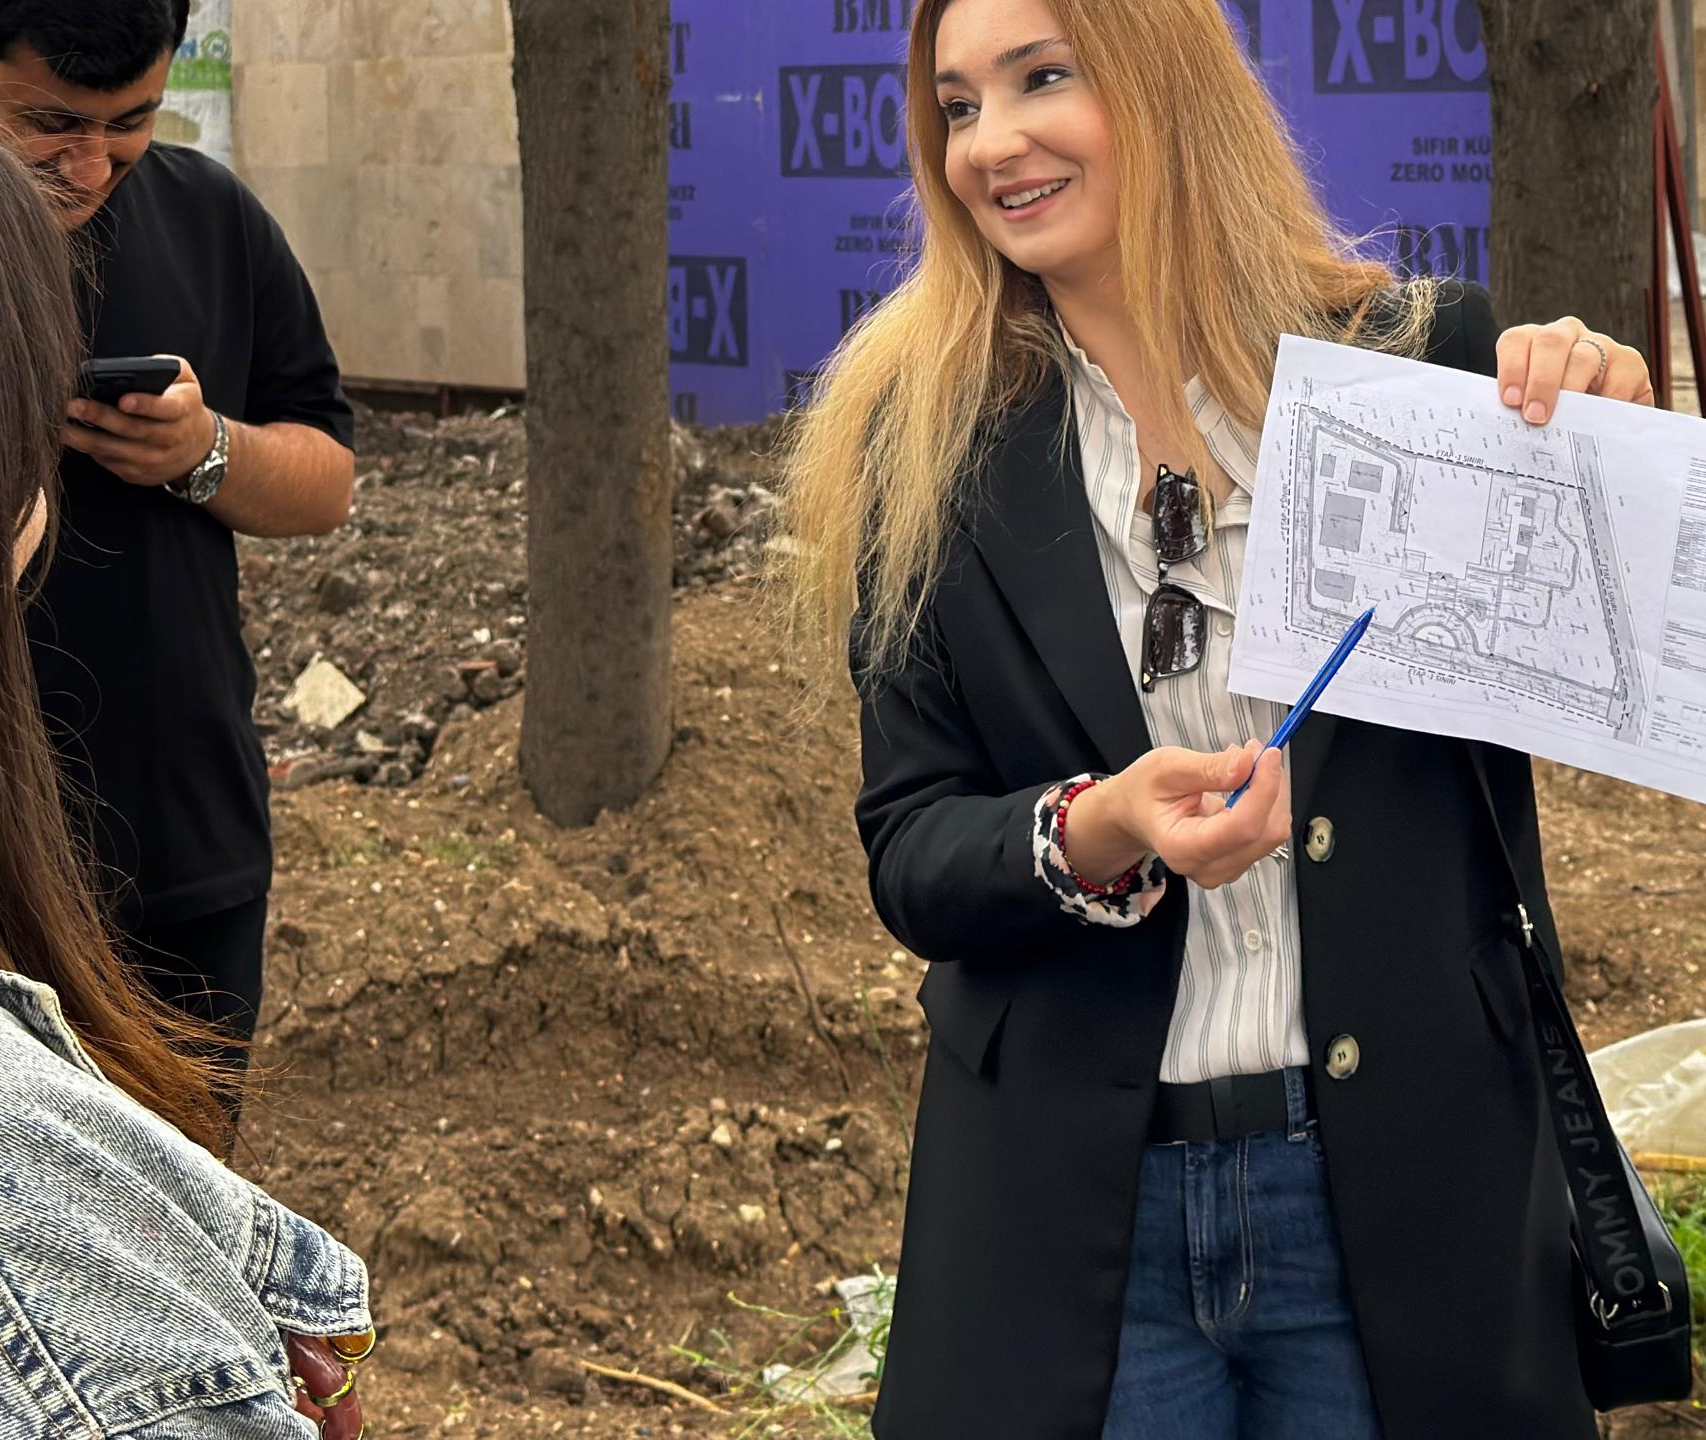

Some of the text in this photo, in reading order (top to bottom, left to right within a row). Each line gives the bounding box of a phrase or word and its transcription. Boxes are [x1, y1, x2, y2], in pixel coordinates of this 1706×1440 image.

[789, 73, 907, 171] X-BO
[1412, 133, 1493, 157] SIFIR KÜ
[1390, 163, 1445, 183] ZERO
[1399, 224, 1492, 278] BM
[1435, 448, 1454, 459] ETAP
[1543, 1024, 1646, 1297] OMMY JEANS
